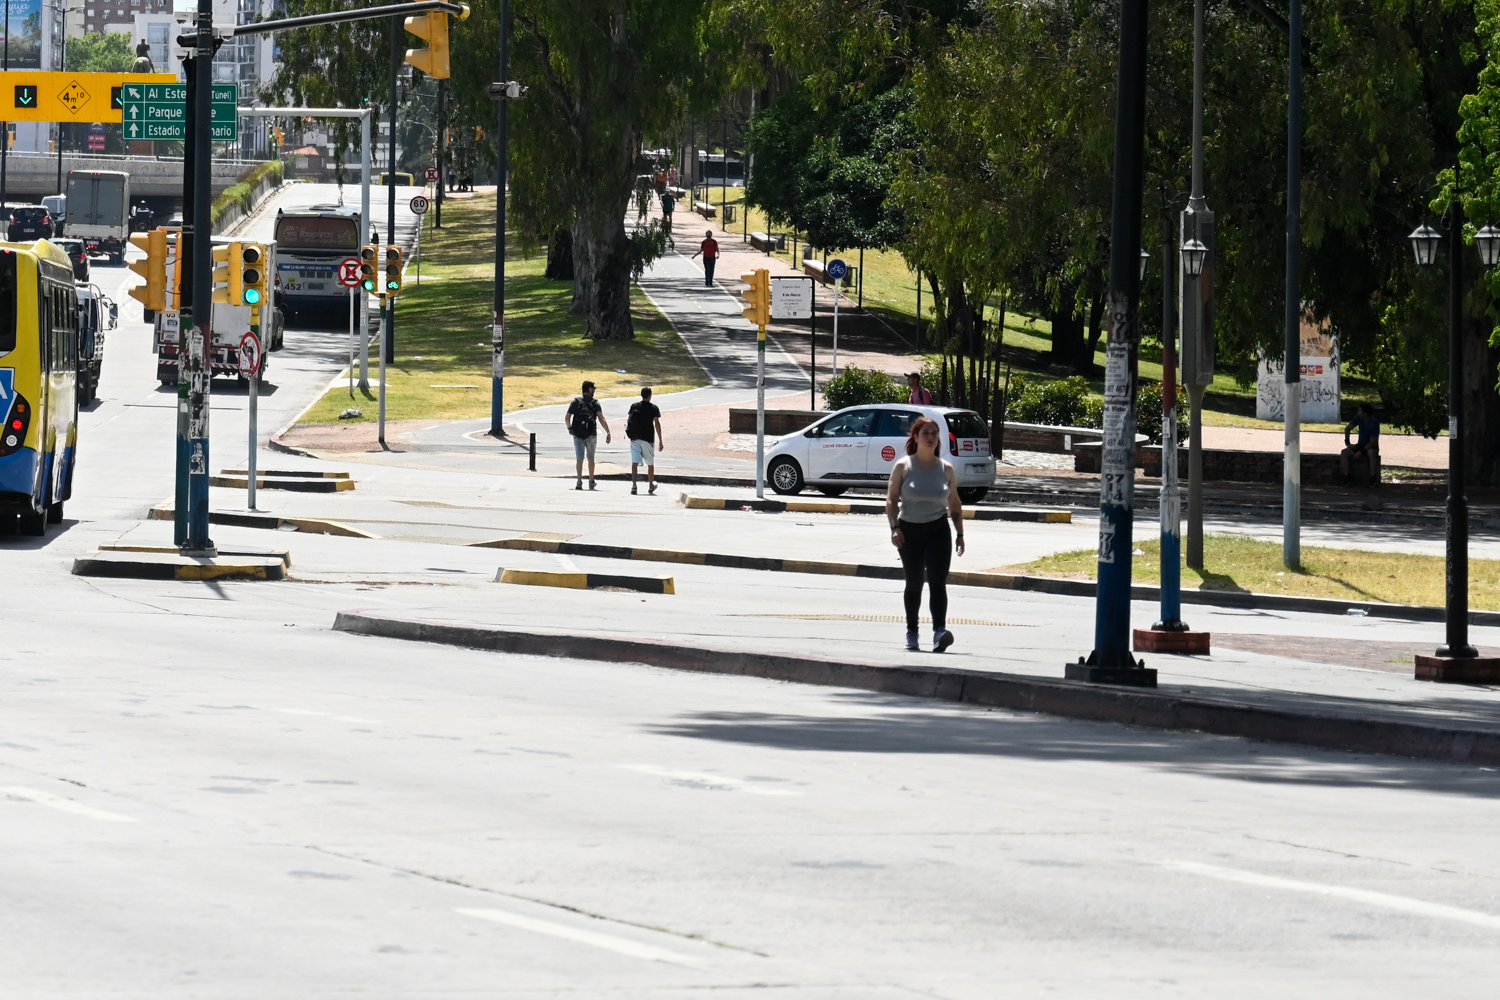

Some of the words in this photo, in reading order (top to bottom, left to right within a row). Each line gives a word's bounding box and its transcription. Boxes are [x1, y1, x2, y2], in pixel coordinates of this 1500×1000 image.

[148, 88, 160, 99] Al
[165, 88, 186, 100] Este
[148, 107, 182, 119] Parque
[148, 124, 181, 136] Estadio
[413, 199, 425, 208] 60
[284, 283, 302, 291] 452
